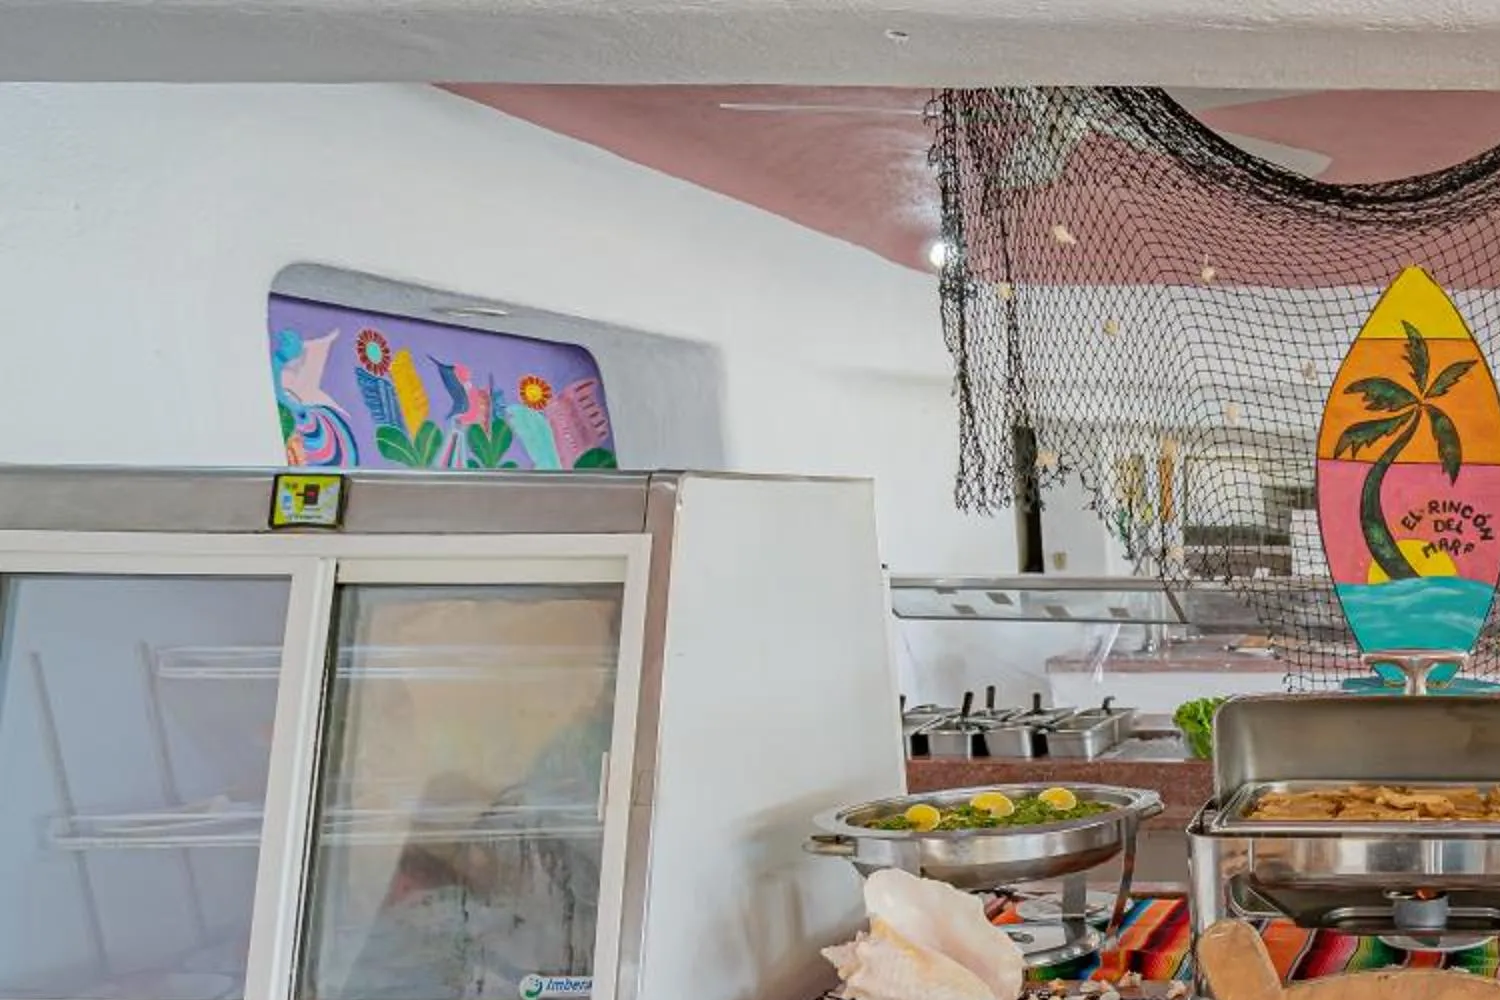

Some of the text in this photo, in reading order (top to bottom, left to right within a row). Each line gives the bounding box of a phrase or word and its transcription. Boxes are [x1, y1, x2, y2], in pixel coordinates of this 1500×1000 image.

[1401, 499, 1495, 541] EL RINCÓN
[1433, 518, 1463, 535] DEL
